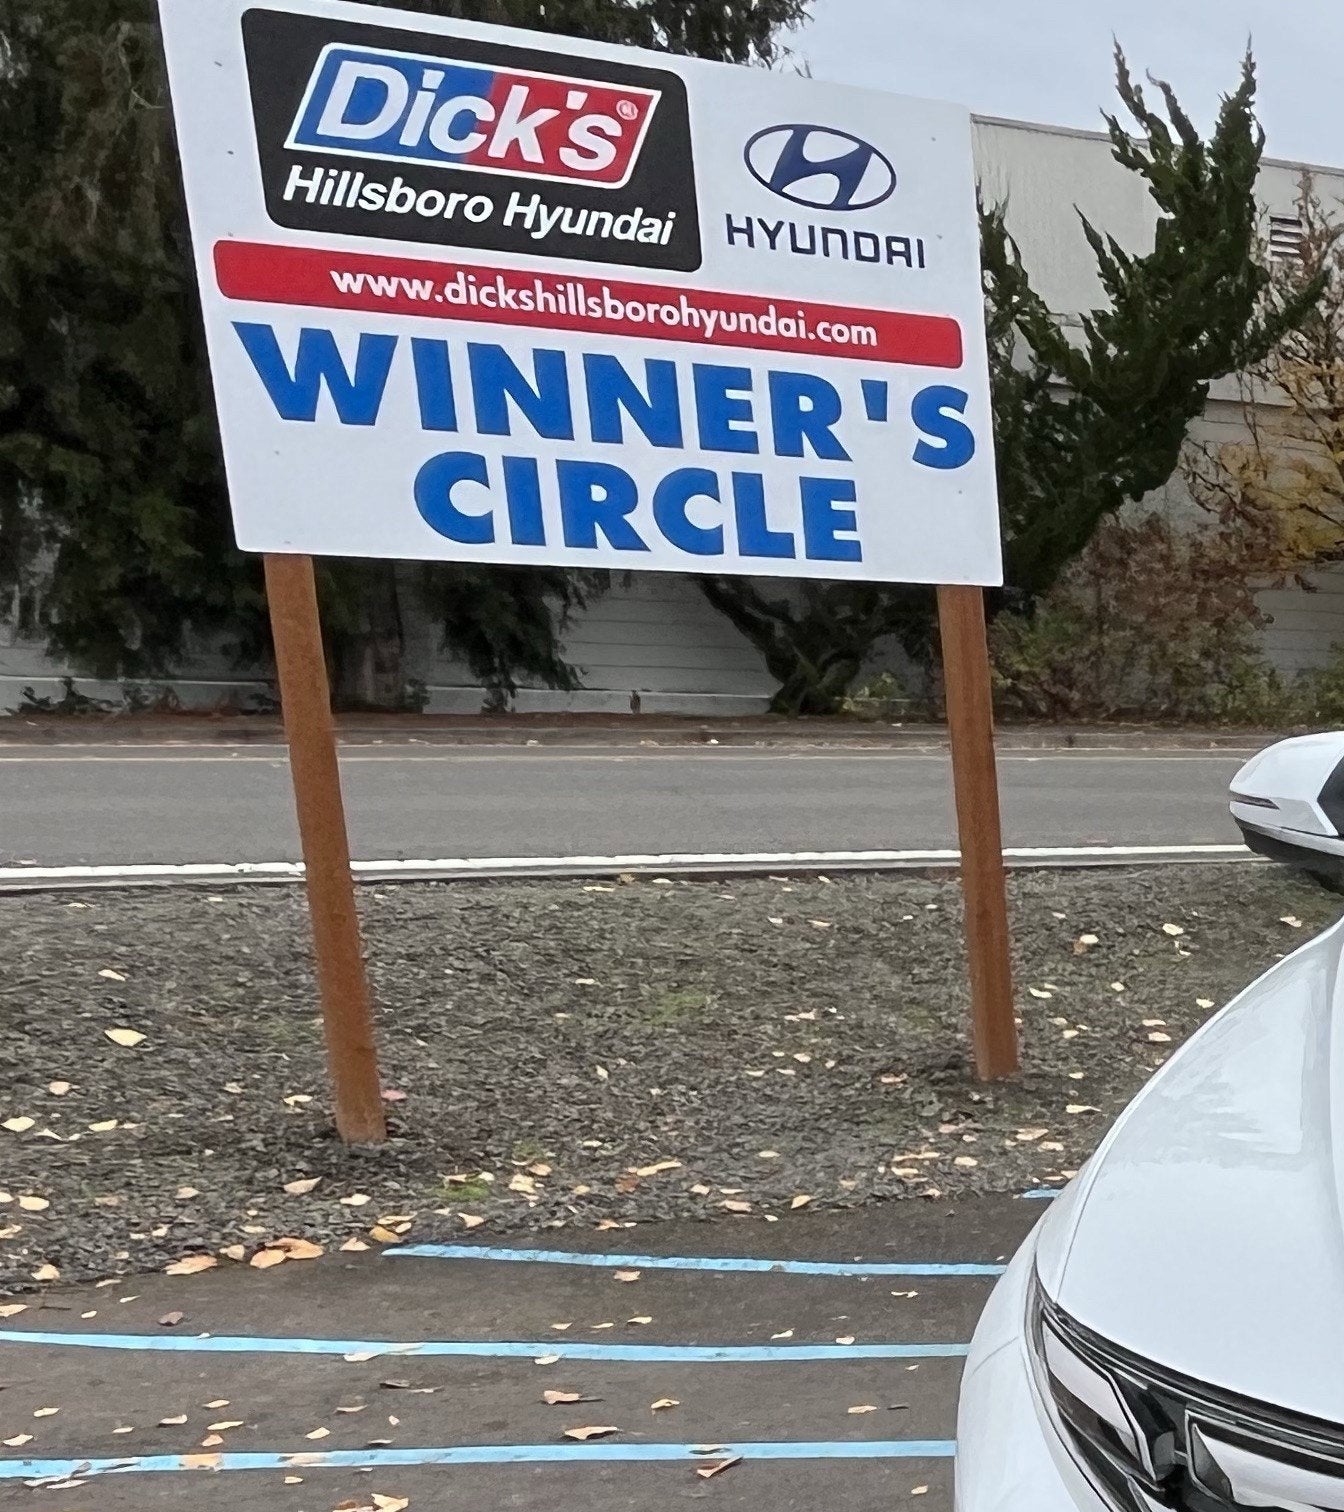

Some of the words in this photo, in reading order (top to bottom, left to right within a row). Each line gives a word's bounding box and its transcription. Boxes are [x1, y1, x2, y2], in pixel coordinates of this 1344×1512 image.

[283, 166, 493, 224] Hillsboro
[503, 195, 677, 246] Hyundai
[726, 215, 925, 269] HYUNDAI
[331, 270, 879, 348] www.dickshillsborohyundai.com
[232, 322, 976, 470] WINNER'S
[413, 451, 863, 563] CIRCLE
